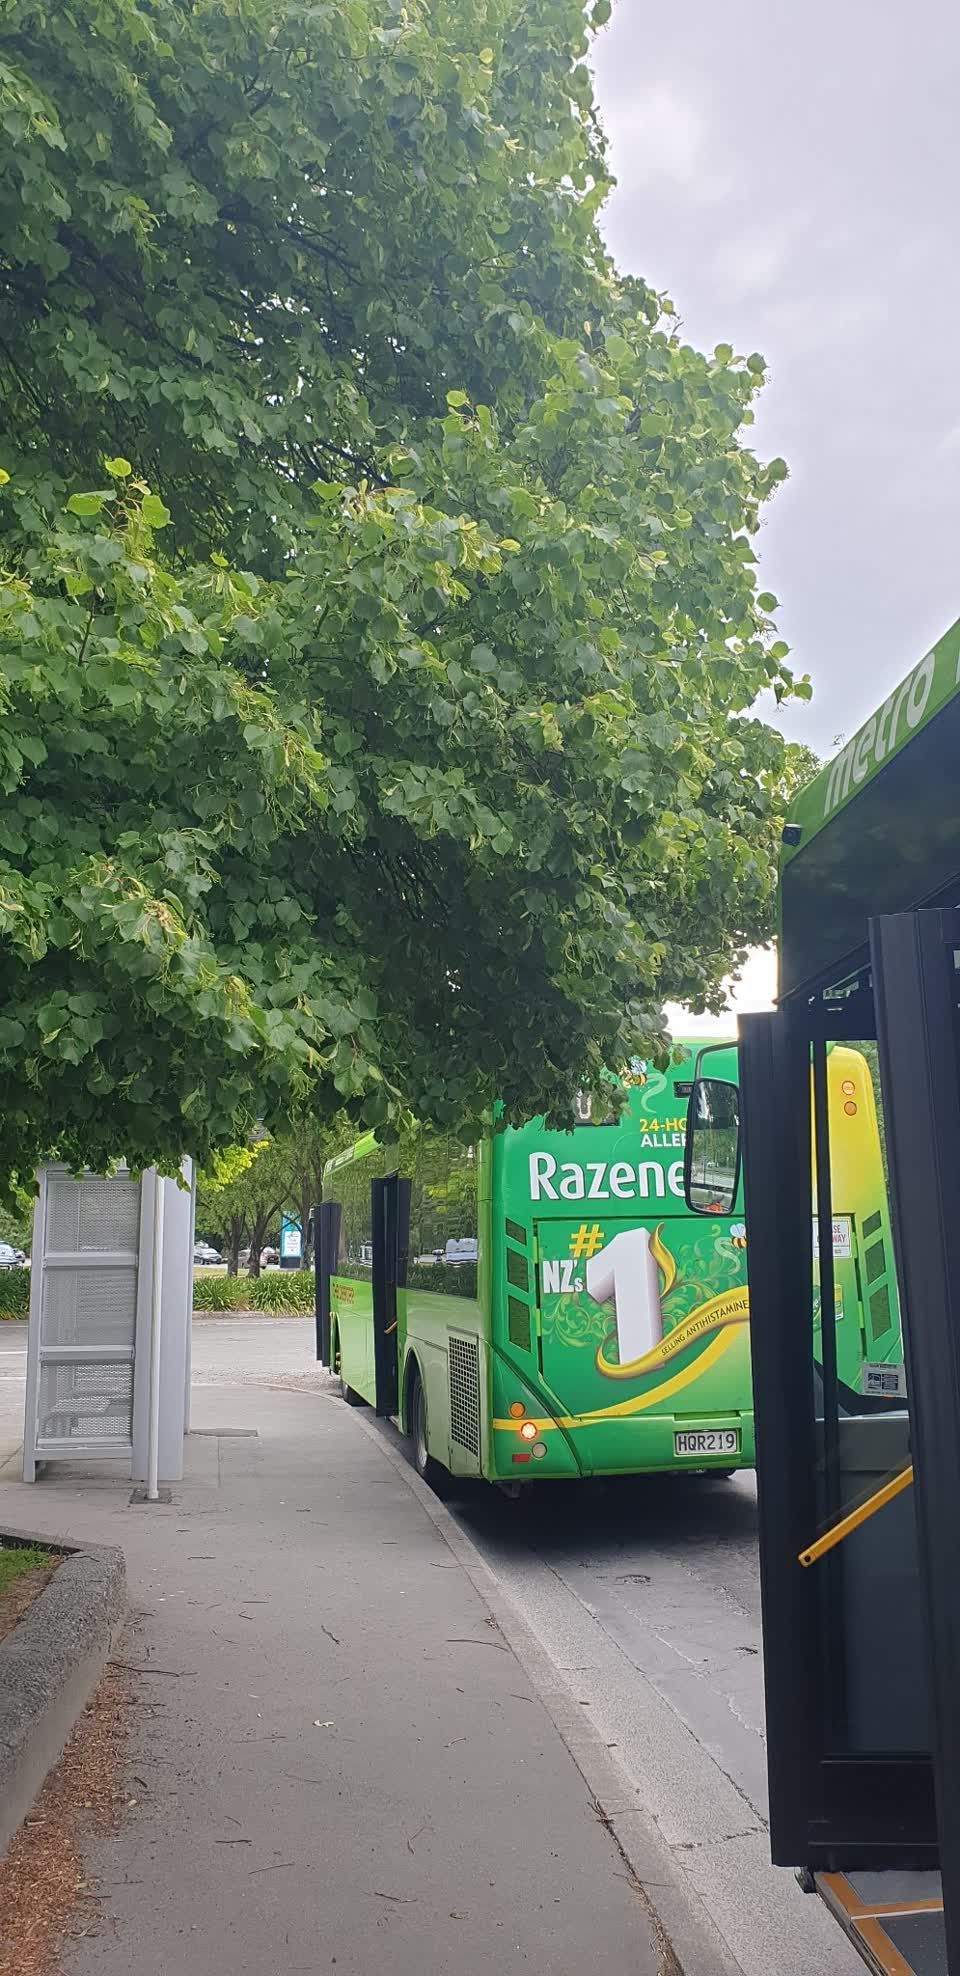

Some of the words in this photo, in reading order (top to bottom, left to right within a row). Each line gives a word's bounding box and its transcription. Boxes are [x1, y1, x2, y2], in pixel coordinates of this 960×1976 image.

[824, 652, 936, 817] metro
[661, 1334, 686, 1356] SELLING
[686, 1299, 749, 1337] ANTIHISTAMINE
[678, 1433, 735, 1451] HQR219
